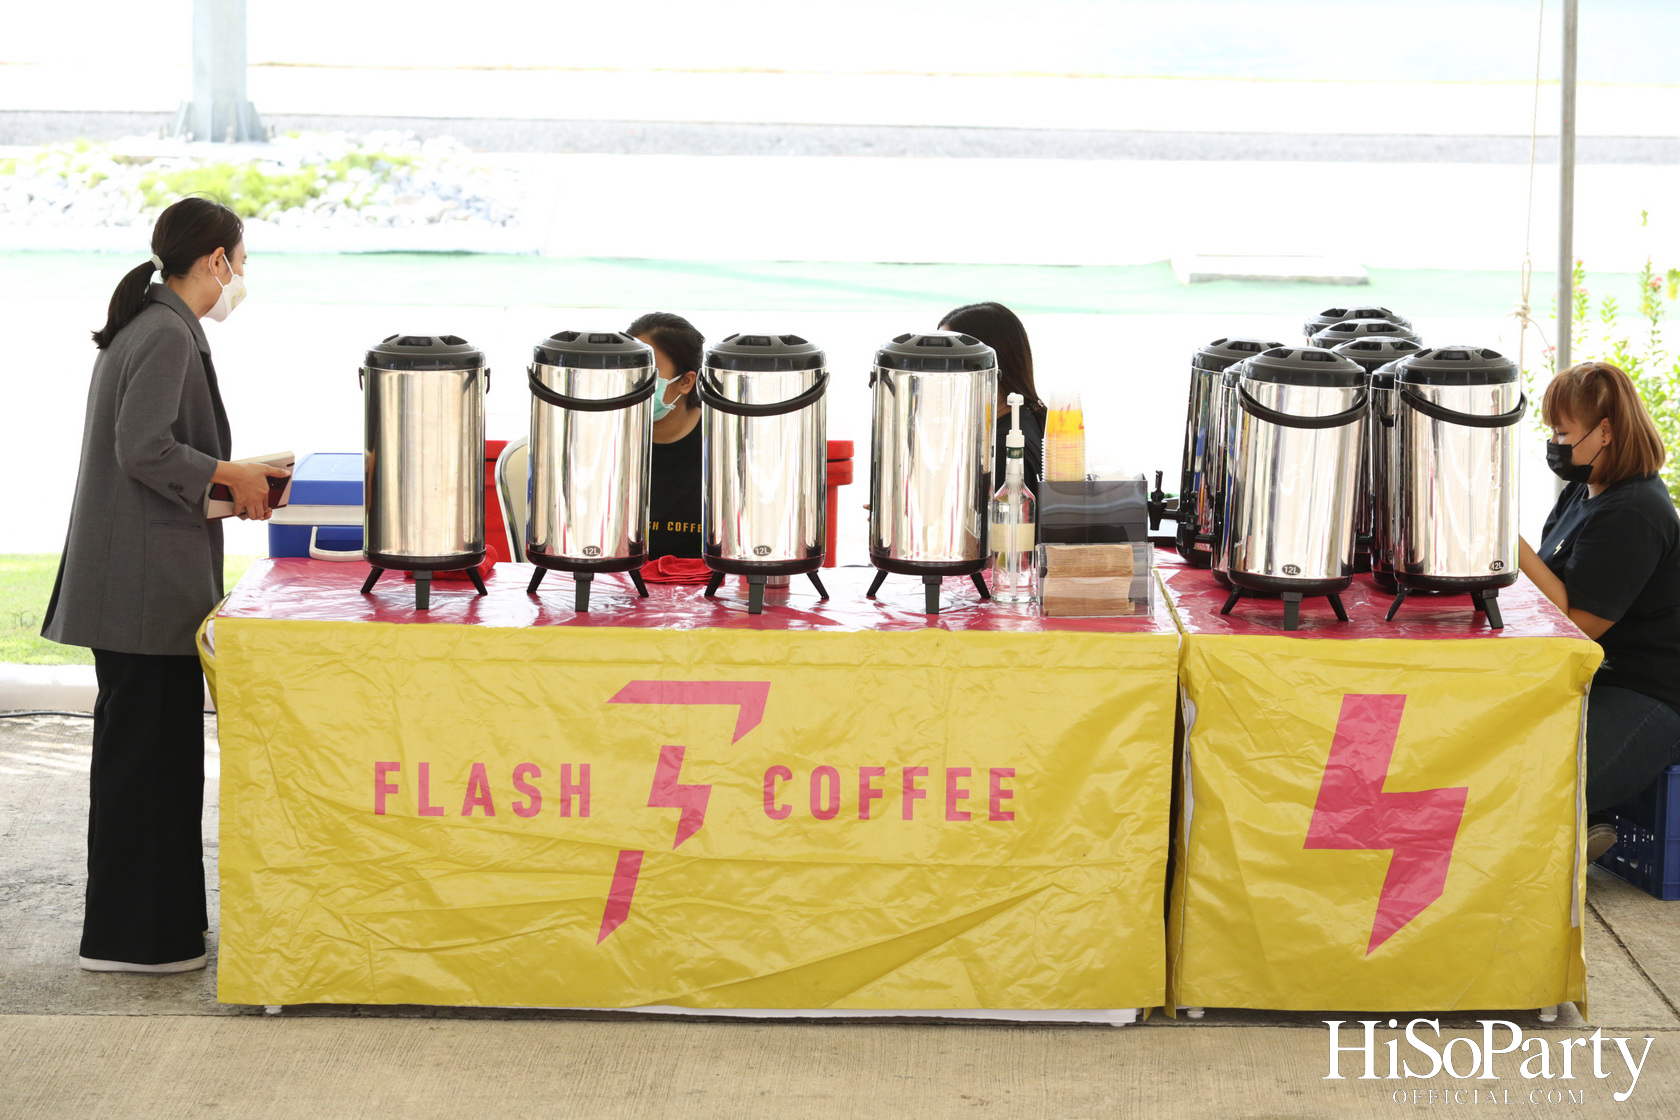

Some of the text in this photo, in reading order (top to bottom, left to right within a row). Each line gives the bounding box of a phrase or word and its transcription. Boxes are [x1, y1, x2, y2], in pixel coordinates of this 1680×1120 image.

[584, 547, 599, 555] 12L
[755, 547, 770, 555] 12L
[1284, 566, 1299, 574] 12L
[374, 761, 1016, 821] FLASH COFFEE
